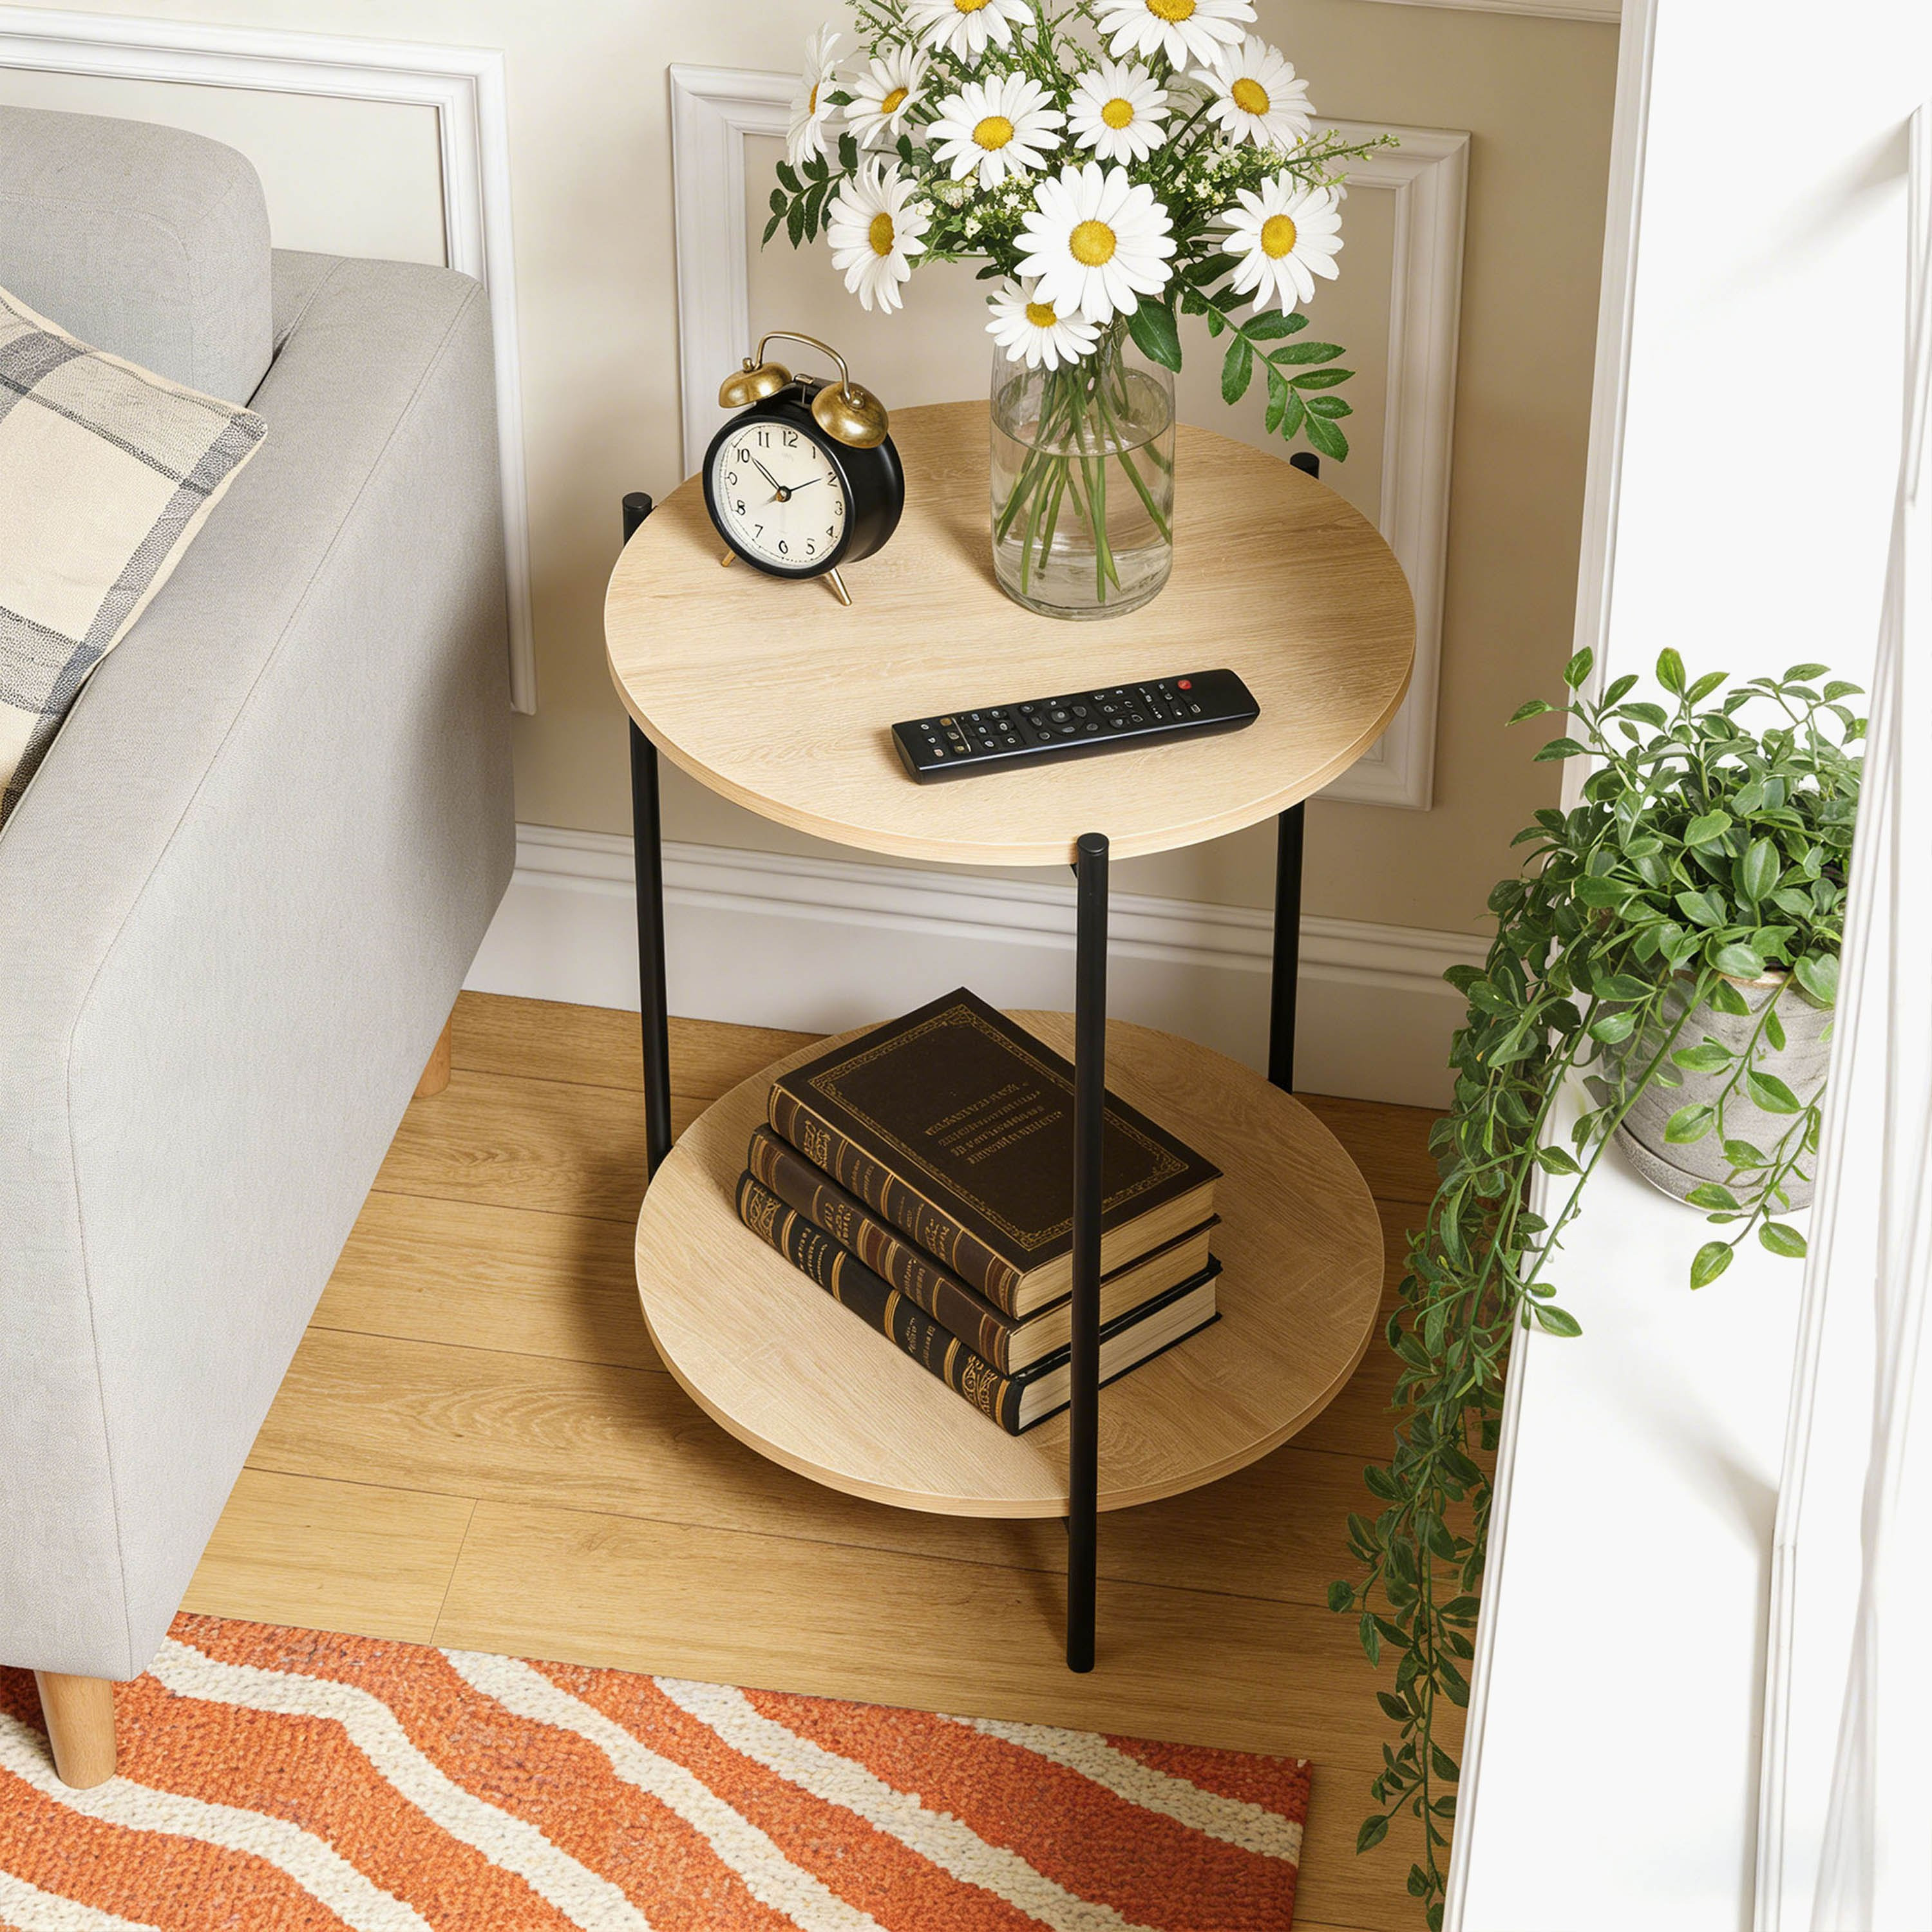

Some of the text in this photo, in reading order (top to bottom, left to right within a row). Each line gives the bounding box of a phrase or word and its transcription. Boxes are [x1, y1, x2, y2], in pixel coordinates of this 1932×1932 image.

[758, 431, 770, 448] 11
[782, 430, 799, 448] 12
[736, 448, 750, 463] 10
[812, 446, 816, 459] 1
[827, 471, 838, 488] 2
[736, 500, 746, 516] 8
[835, 500, 843, 516] 3
[755, 524, 764, 538] 7
[826, 526, 834, 537] 4
[805, 538, 815, 555] 5
